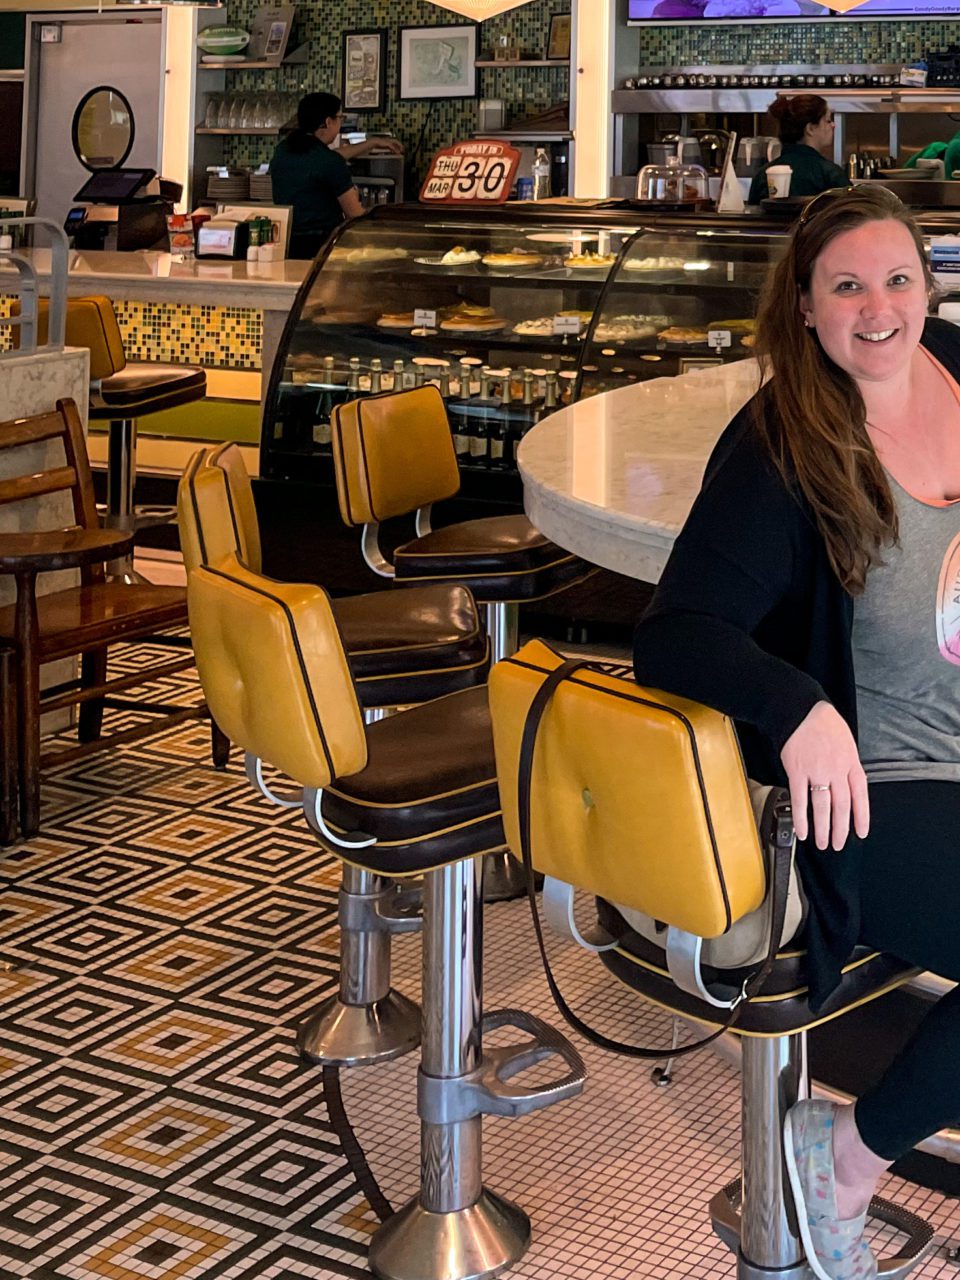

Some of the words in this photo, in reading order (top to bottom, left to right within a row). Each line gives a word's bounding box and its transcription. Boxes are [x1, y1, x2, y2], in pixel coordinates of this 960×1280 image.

[437, 160, 459, 172] THU
[457, 161, 506, 193] 30
[427, 182, 450, 195] MAR
